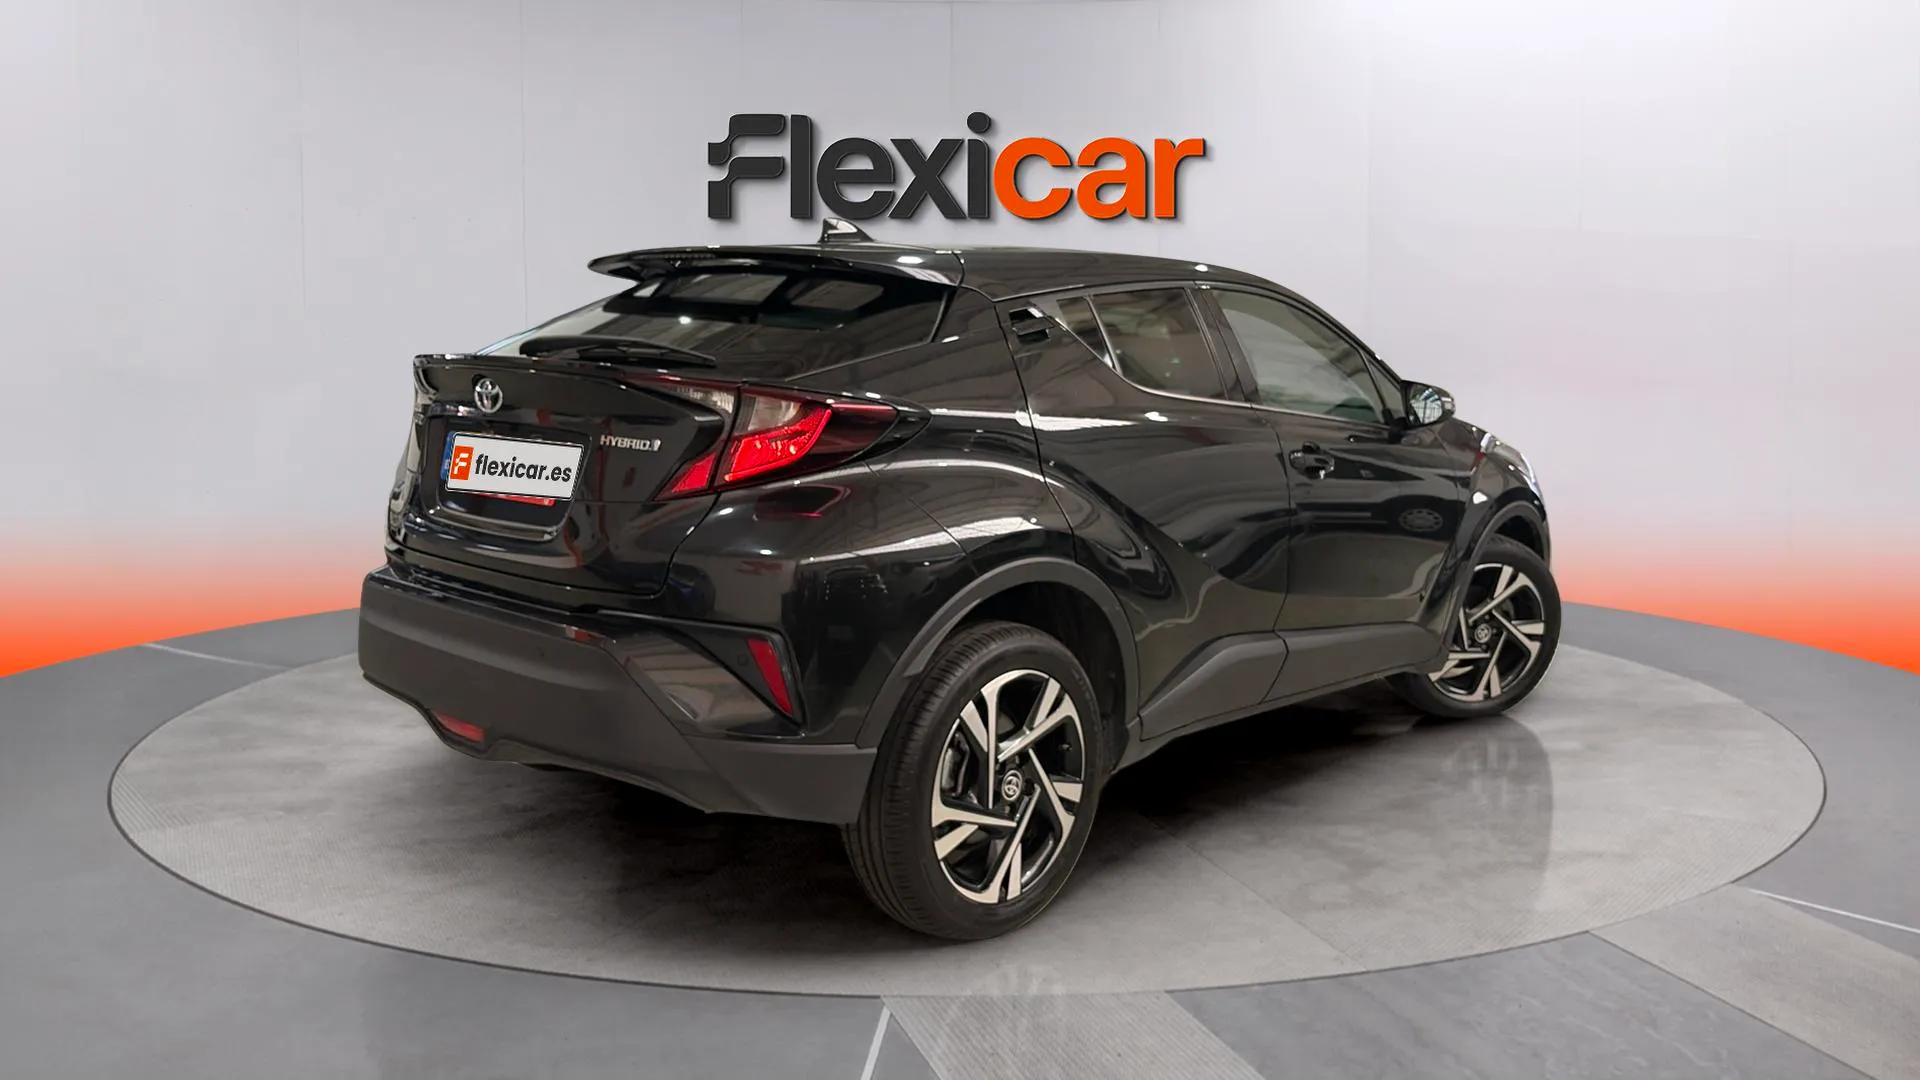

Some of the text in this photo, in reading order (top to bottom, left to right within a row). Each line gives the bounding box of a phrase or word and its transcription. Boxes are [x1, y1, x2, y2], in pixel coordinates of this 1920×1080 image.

[707, 112, 1205, 219] Flexicar
[600, 434, 650, 450] HYBRID
[474, 453, 572, 482] flexicar.es
